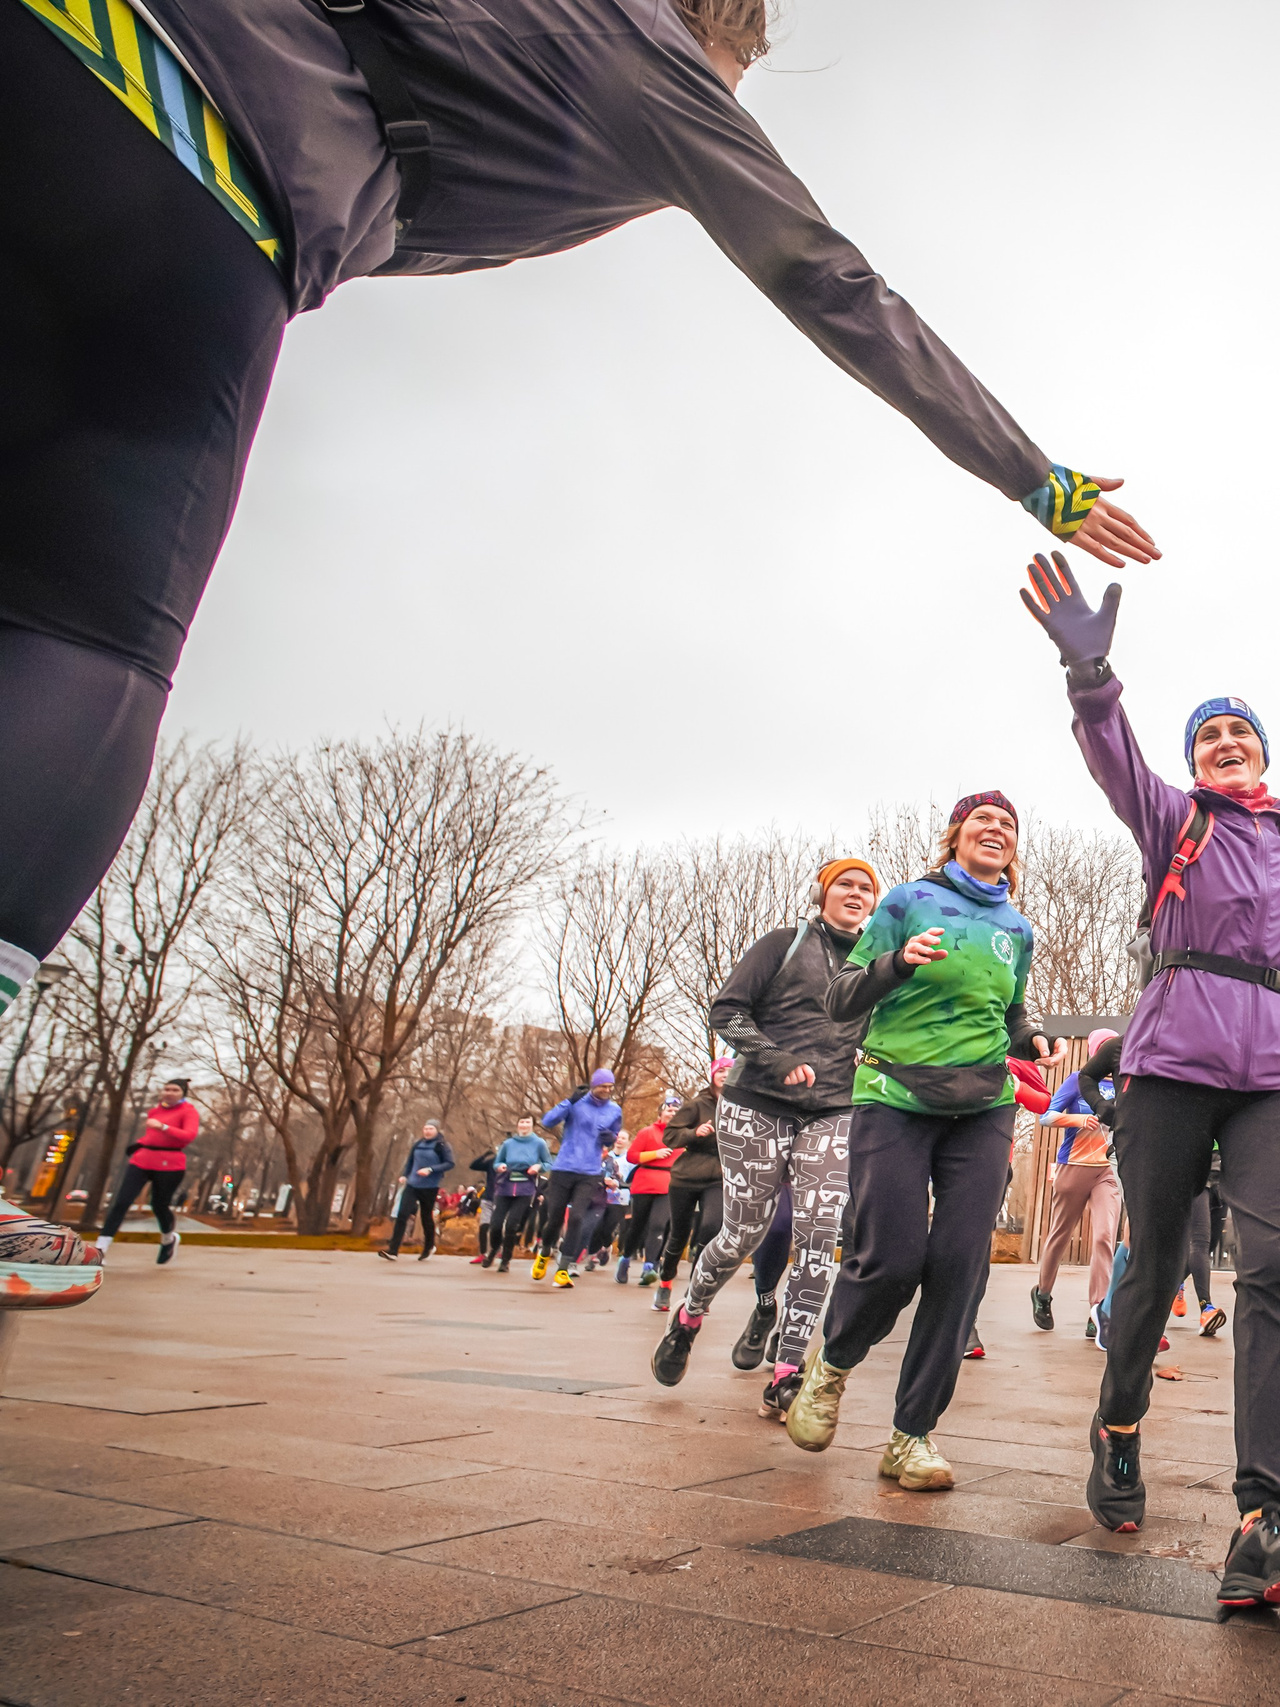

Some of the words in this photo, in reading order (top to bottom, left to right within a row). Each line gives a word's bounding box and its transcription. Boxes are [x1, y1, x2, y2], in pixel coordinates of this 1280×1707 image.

[718, 1115, 755, 1138] FILA
[722, 1165, 747, 1187] ILA
[807, 1249, 836, 1268] FIL
[785, 1321, 812, 1340] FIL
